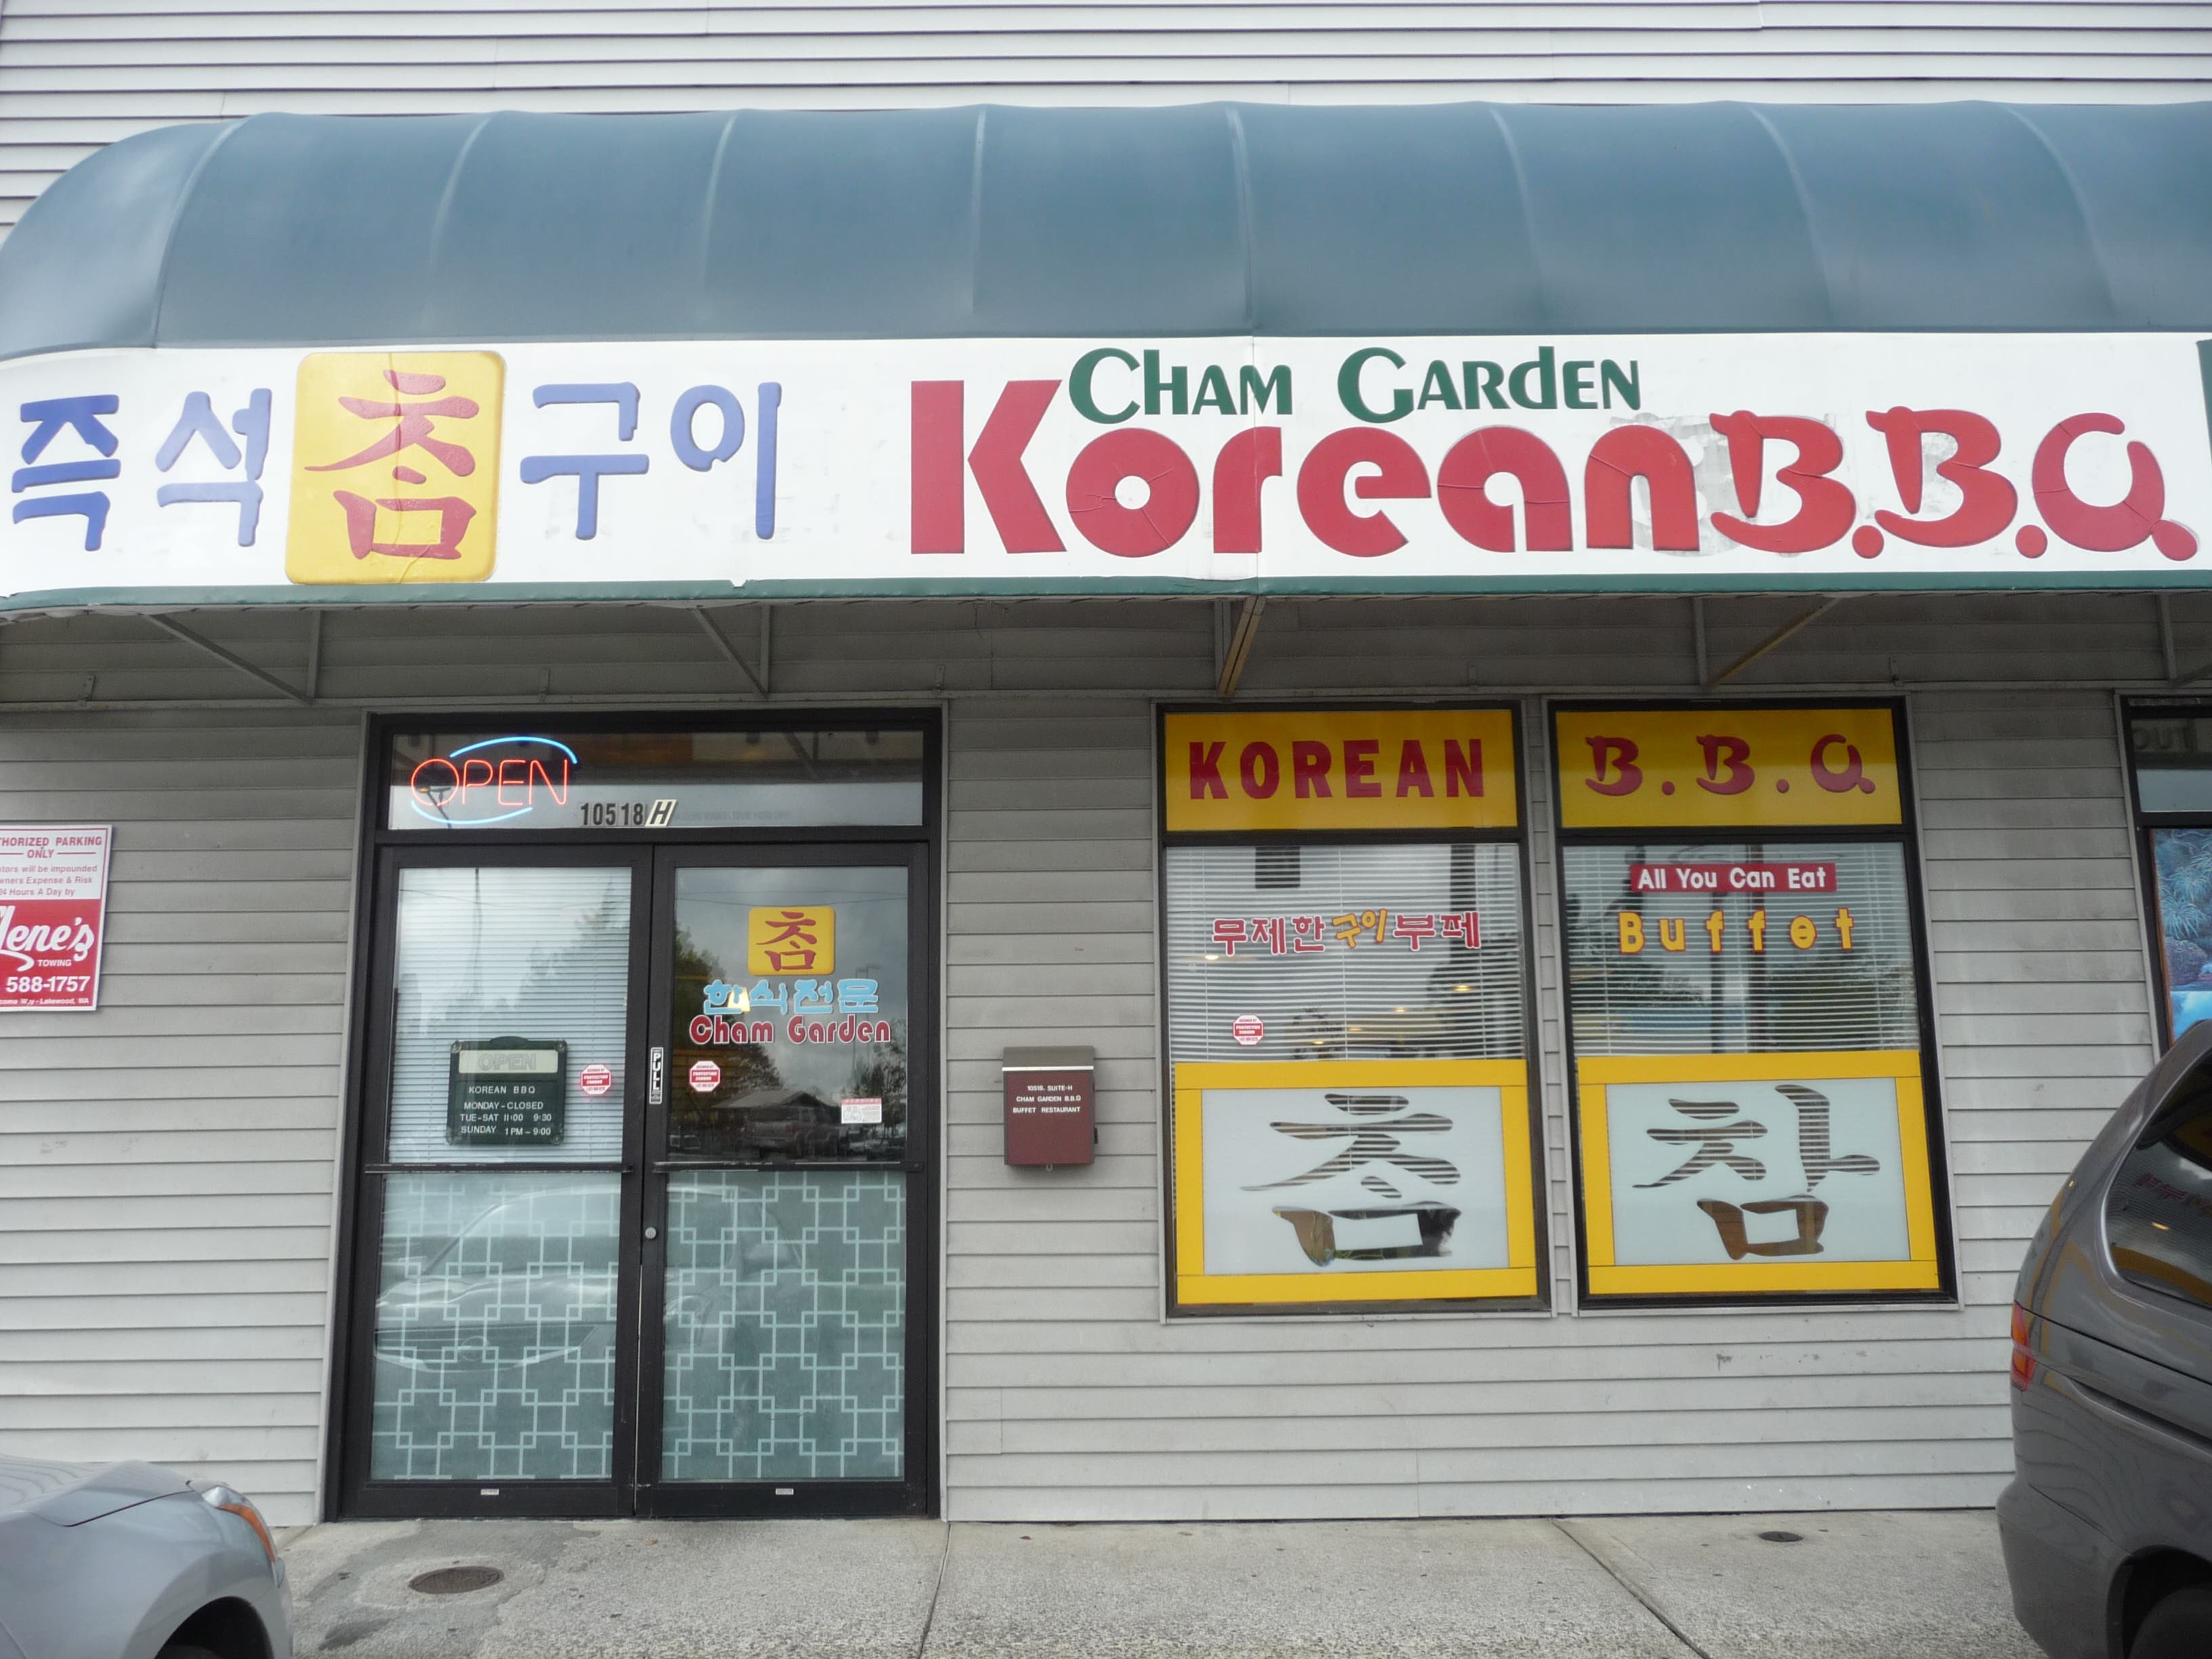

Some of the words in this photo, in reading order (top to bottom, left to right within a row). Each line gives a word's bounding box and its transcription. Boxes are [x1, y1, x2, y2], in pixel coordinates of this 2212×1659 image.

[12, 388, 272, 551] 즉석
[520, 381, 783, 540] 구이
[911, 380, 1701, 558] Korean
[1189, 738, 1484, 800] KOREAN
[411, 758, 568, 806] OPEN
[0, 837, 49, 846] HORIZED
[56, 836, 102, 846] PARKING
[27, 849, 54, 858] ONLY
[51, 865, 98, 874] impounded
[1637, 869, 1667, 889] All
[1677, 868, 1717, 888] You
[1729, 867, 1776, 888] Can
[1788, 866, 1826, 888] Eat
[26, 876, 64, 885] Expense
[46, 888, 62, 897] Day
[65, 888, 75, 897] by
[1618, 907, 1854, 954] Buffet
[37, 959, 72, 967] TOWING
[5, 976, 90, 993] 588-1757
[689, 1015, 775, 1044] Cham
[787, 1014, 891, 1044] Garden
[477, 1052, 537, 1071] OPEN
[652, 1052, 661, 1090] PULL
[468, 1086, 507, 1094] KOREAN
[533, 1113, 552, 1122] 9:30
